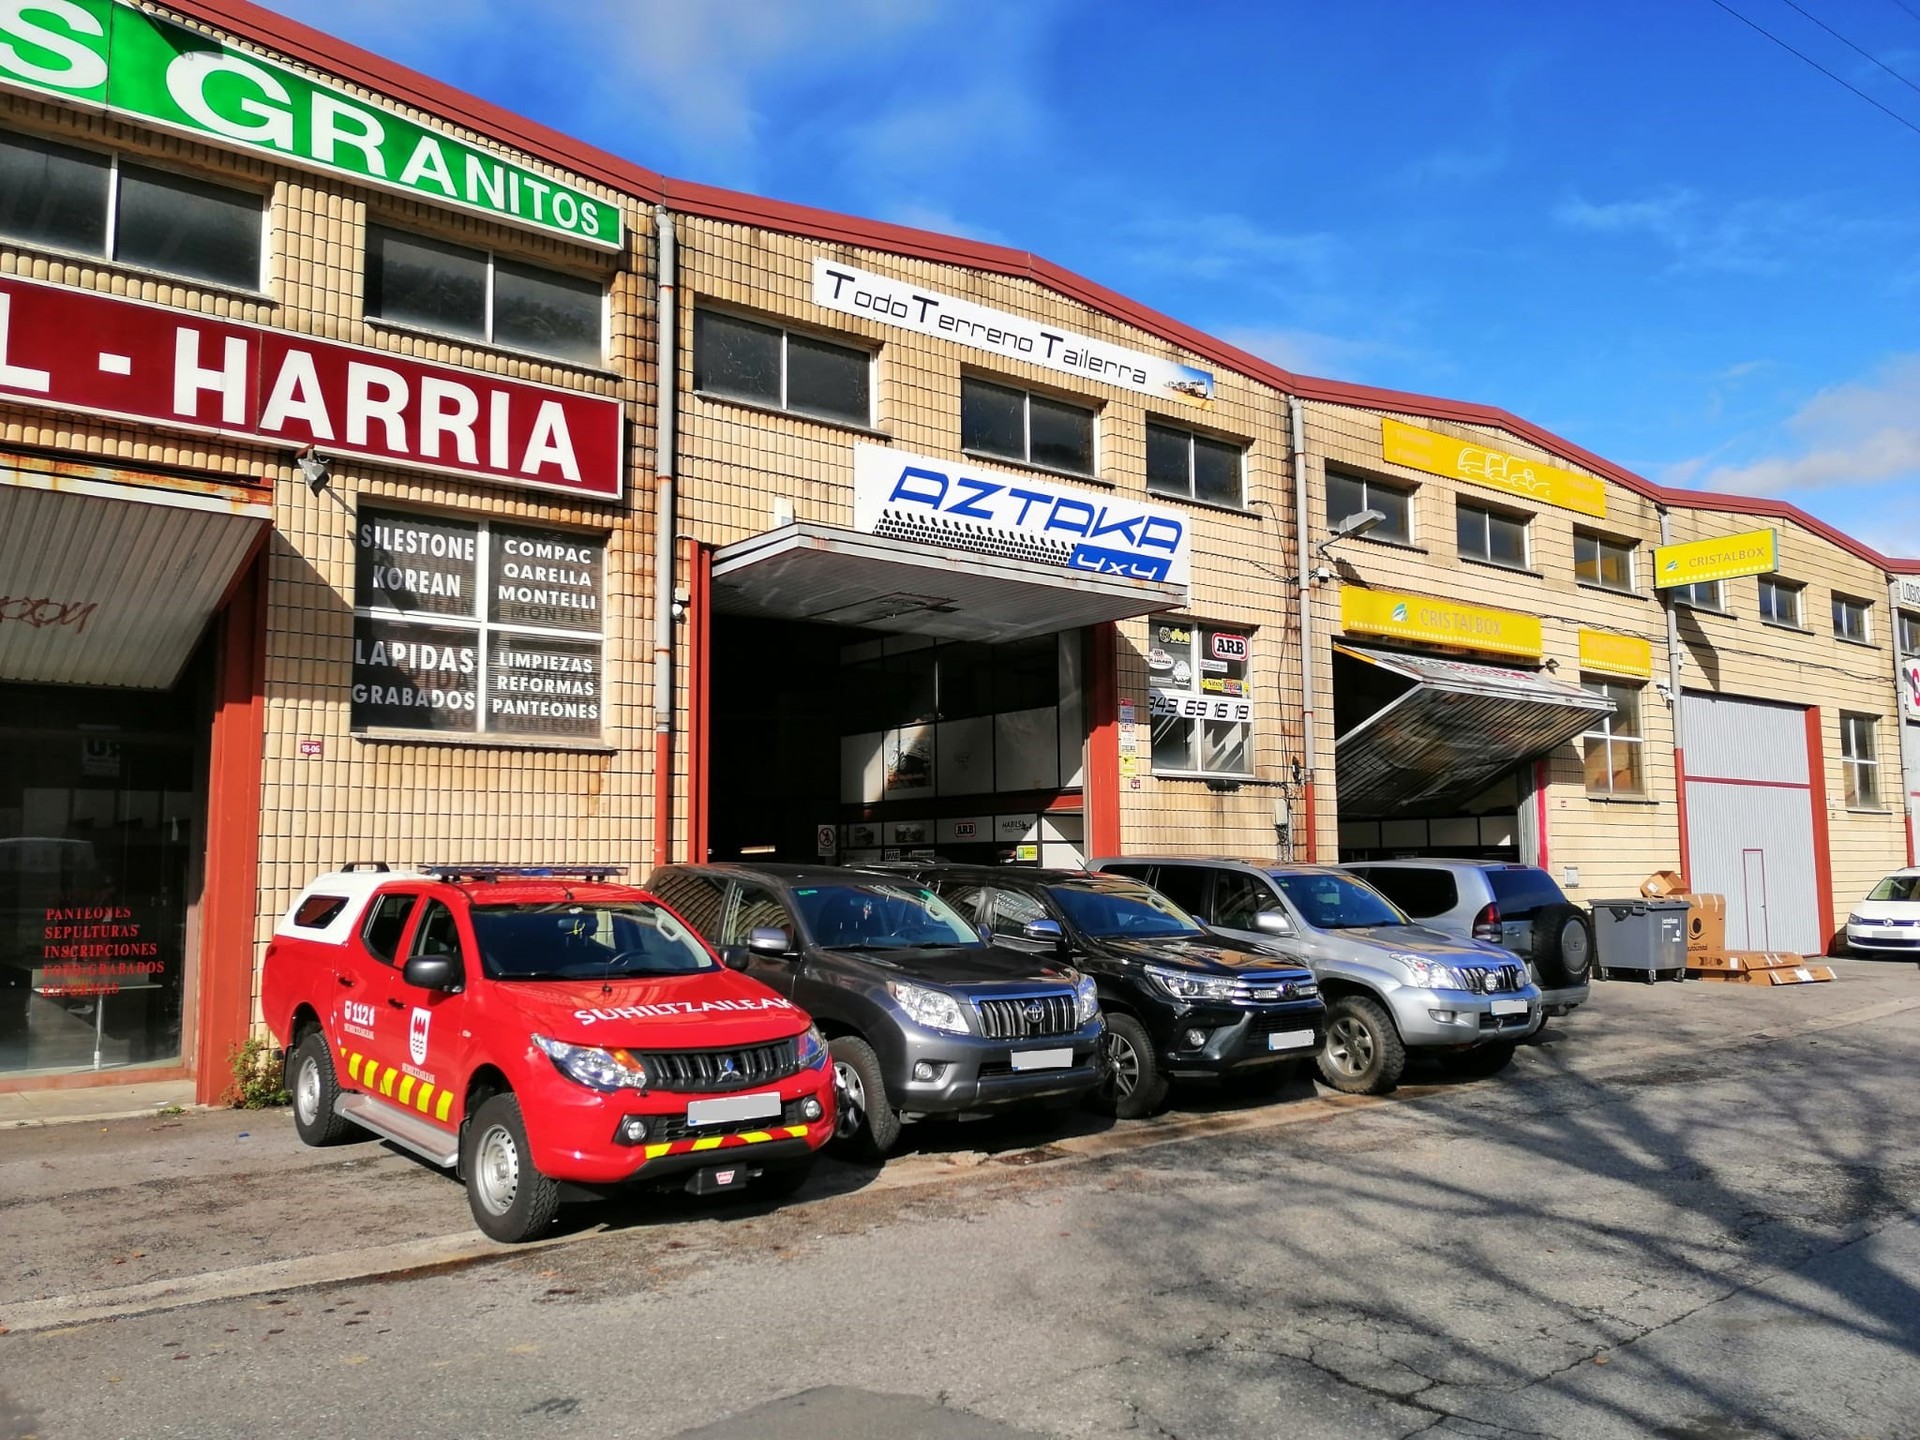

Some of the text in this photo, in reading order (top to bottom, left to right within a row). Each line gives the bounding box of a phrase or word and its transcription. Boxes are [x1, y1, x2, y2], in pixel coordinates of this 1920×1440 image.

[166, 51, 600, 237] GRANITOS
[826, 269, 1146, 385] Todo Terreno Tailerra
[173, 327, 582, 482] HARRIA
[889, 466, 1183, 554] AZTAKA
[361, 524, 475, 561] SILESTONE
[504, 539, 592, 564] COMPAC
[1689, 547, 1765, 568] CRISTALBOX
[372, 565, 461, 597] KOREAN
[503, 562, 592, 587] QARELLA
[498, 585, 596, 609] MONTELLI
[1420, 608, 1500, 635] CRISTALBOX
[355, 639, 474, 673] LAPIDAS
[1217, 638, 1244, 655] ARB
[499, 652, 594, 673] LIMPIEZAS
[352, 684, 476, 711] GRABADOS
[497, 676, 595, 696] REFORMAS
[492, 699, 598, 719] PANTEONES
[1184, 701, 1208, 716] 69
[1214, 703, 1228, 718] 16
[1235, 705, 1249, 719] 19
[46, 906, 132, 920] PANTEONES
[45, 925, 139, 939] SEPULTURAS
[44, 943, 158, 958] INSCRIPCIONES
[574, 998, 793, 1026] SUHILTZAILEAK
